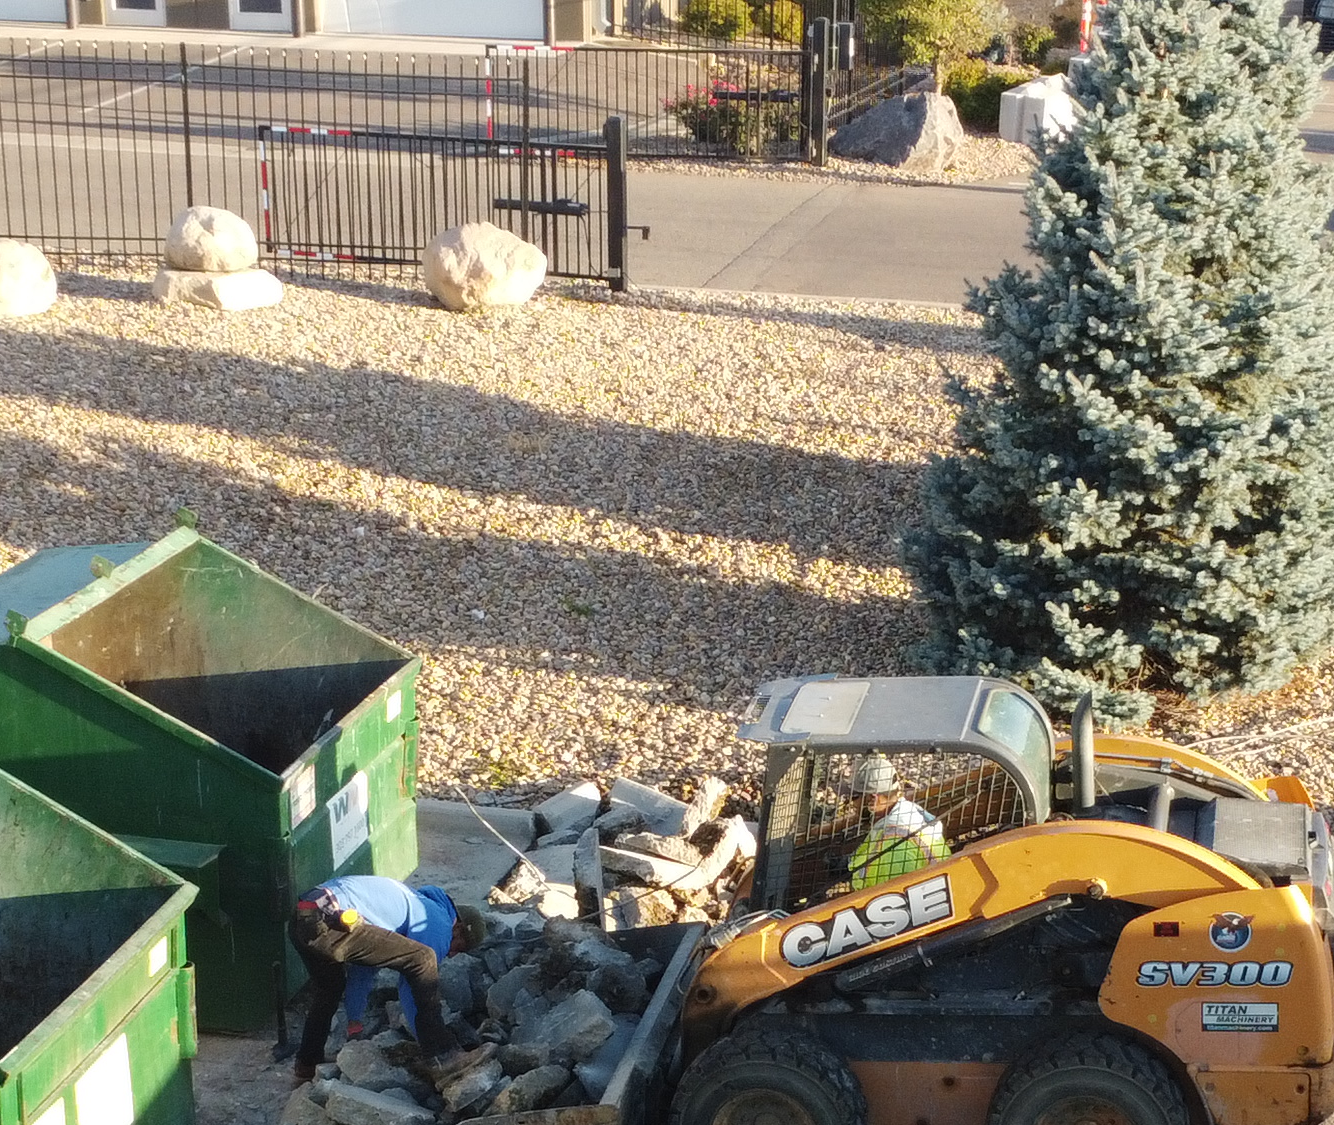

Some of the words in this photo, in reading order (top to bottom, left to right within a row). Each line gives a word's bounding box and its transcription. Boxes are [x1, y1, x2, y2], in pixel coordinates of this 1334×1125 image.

[782, 876, 951, 966] CASE
[1137, 961, 1293, 986] SV300
[1206, 1005, 1248, 1014] TITAN
